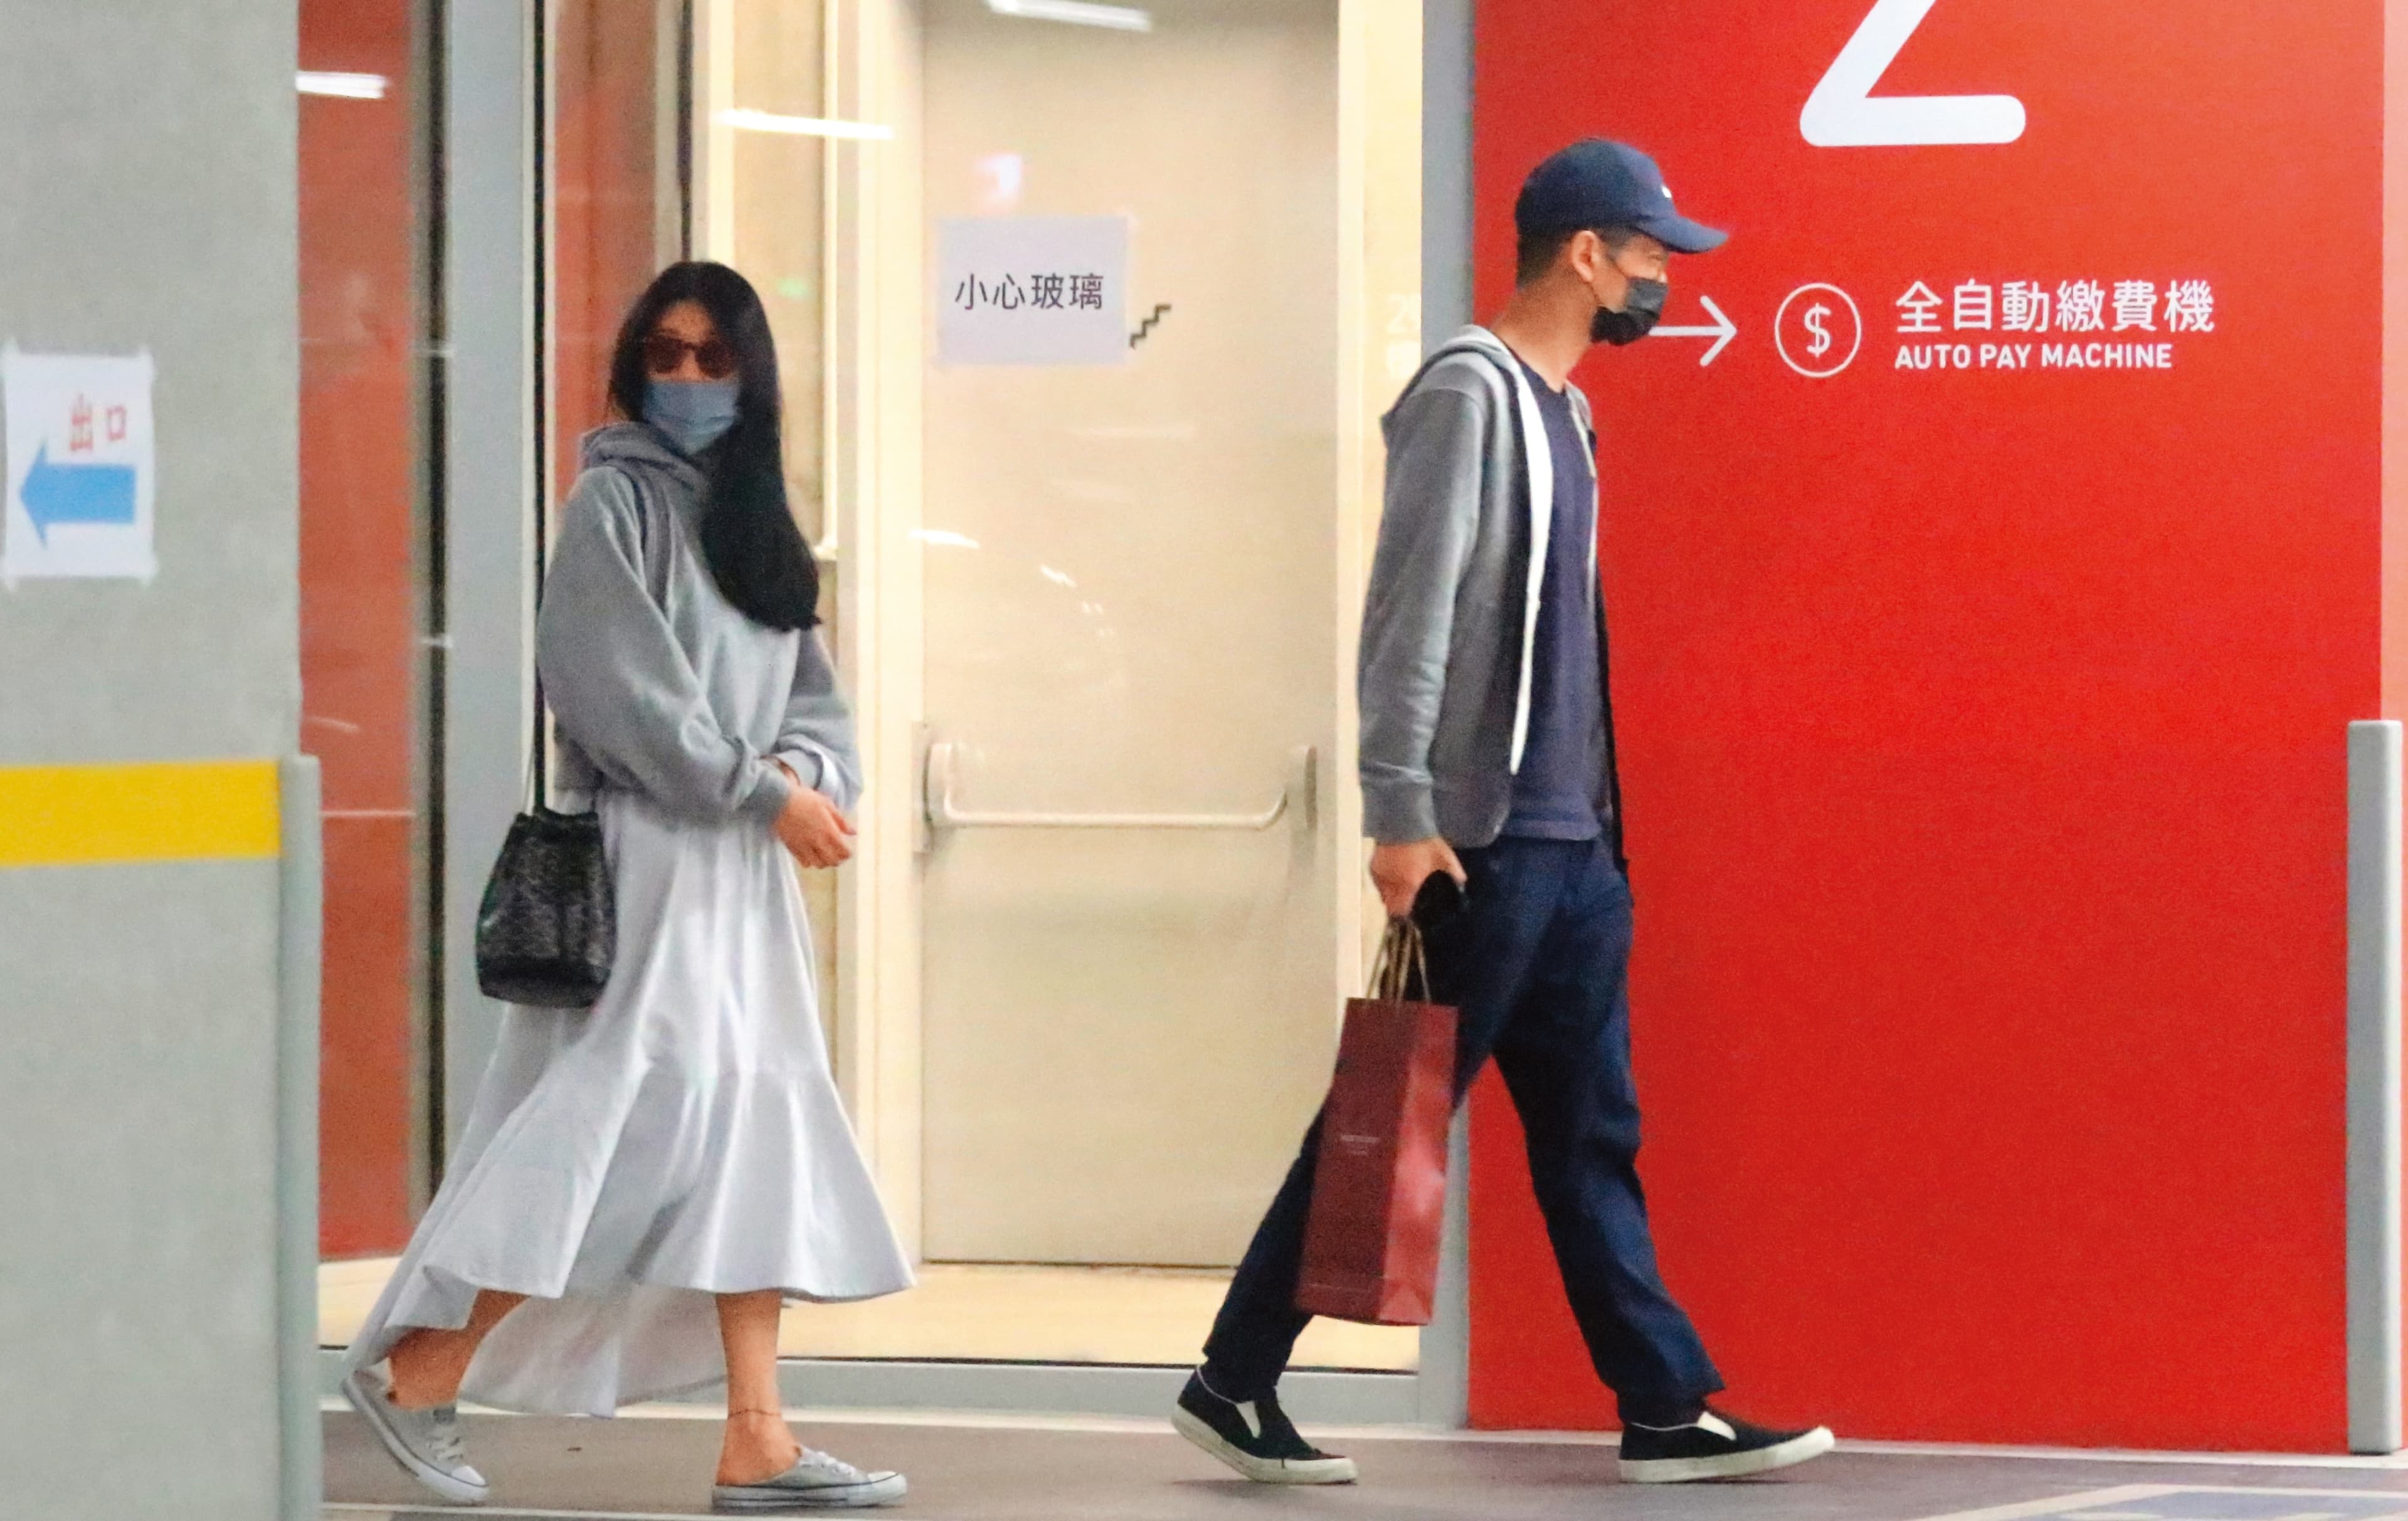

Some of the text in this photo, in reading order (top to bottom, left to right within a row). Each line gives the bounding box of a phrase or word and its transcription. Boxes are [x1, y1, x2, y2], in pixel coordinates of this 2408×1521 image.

[954, 272, 1104, 310] 小心玻璃
[1896, 278, 2215, 333] 全自動繳費機
[1894, 342, 2173, 369] AUTO PAY MACHINE
[70, 394, 126, 451] 出口
